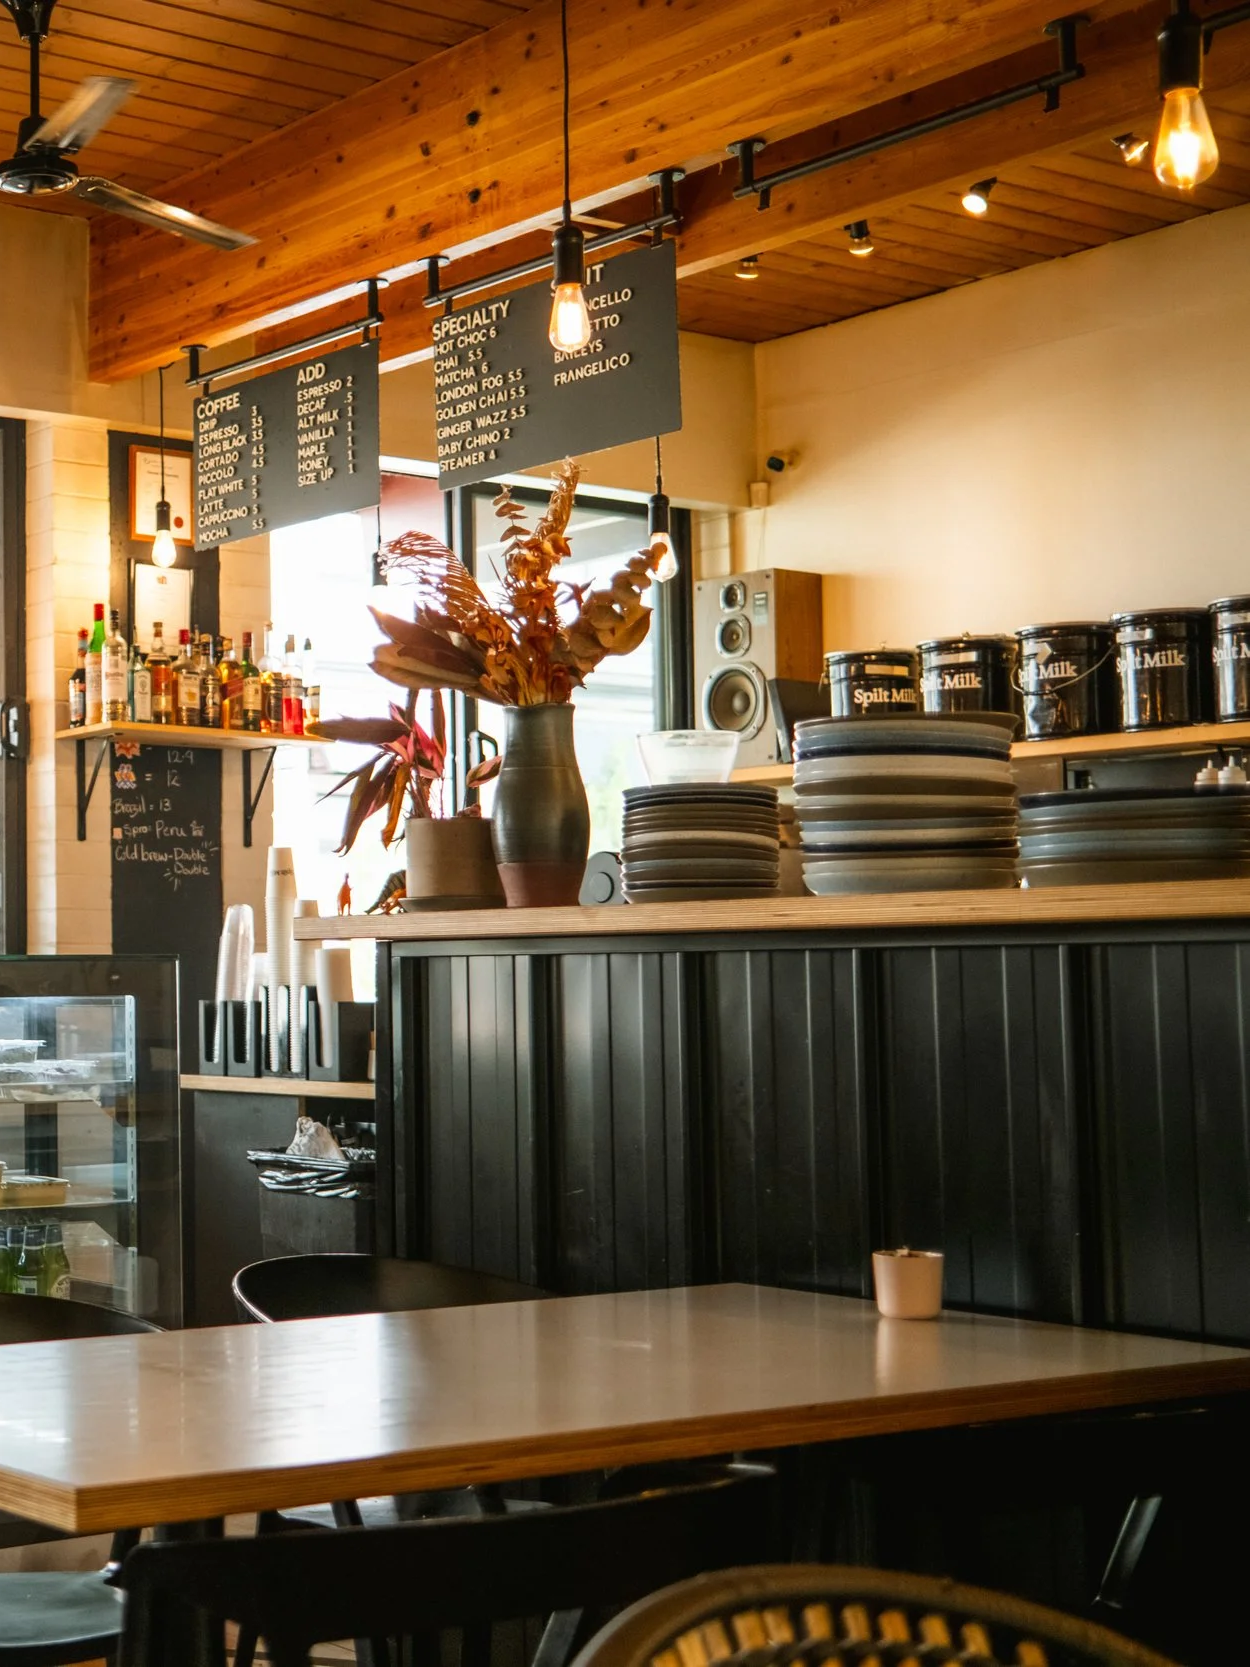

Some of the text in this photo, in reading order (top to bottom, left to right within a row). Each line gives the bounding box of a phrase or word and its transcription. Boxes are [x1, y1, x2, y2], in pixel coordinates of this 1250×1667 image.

[432, 299, 510, 341] SPECIALTY
[434, 326, 497, 357] HOT CHOC 6
[434, 348, 483, 374] CHAI 5.5
[554, 353, 630, 387] FRANGELICO
[297, 363, 326, 386] ADD
[435, 362, 489, 387] MATCHA 6
[436, 368, 523, 405] LONDON FOG 5.5
[297, 375, 353, 402] ESPRESSO 2
[197, 392, 240, 419] COFFEE
[297, 397, 327, 416] DECAF
[436, 385, 526, 421] GOLDEN CHAI 5.5
[199, 405, 257, 433] DRIP 3
[297, 406, 353, 430] ALT MILK 1
[437, 405, 526, 440] GINGER WAZZ 5.5
[199, 424, 239, 446] ESPRESSO
[297, 421, 352, 445] VANILLA 1
[438, 428, 510, 457] BABY CHINO 2
[199, 442, 222, 459] LONG
[222, 434, 248, 451] BLACK
[298, 436, 352, 460] MAPLE 1
[198, 451, 239, 472] CORTADO
[298, 450, 352, 473] HONEY 1
[439, 449, 496, 472] STEAMER 4
[198, 466, 234, 486] PICCOLO
[298, 463, 354, 487] SIZE UP 1
[198, 474, 257, 501] FLAT WHITE 5
[198, 488, 258, 516] LATTE 5
[198, 504, 258, 528] CAPPUCCINO 5
[199, 527, 229, 544] MOCHA
[1038, 661, 1078, 680] Milk
[1142, 649, 1186, 669] Milk
[944, 672, 982, 690] Milk
[854, 688, 890, 707] Spilt
[113, 794, 146, 818] Brazil
[159, 798, 171, 812] 13
[155, 820, 187, 839] Peru
[115, 843, 138, 861] Cold
[173, 861, 210, 876] Double
